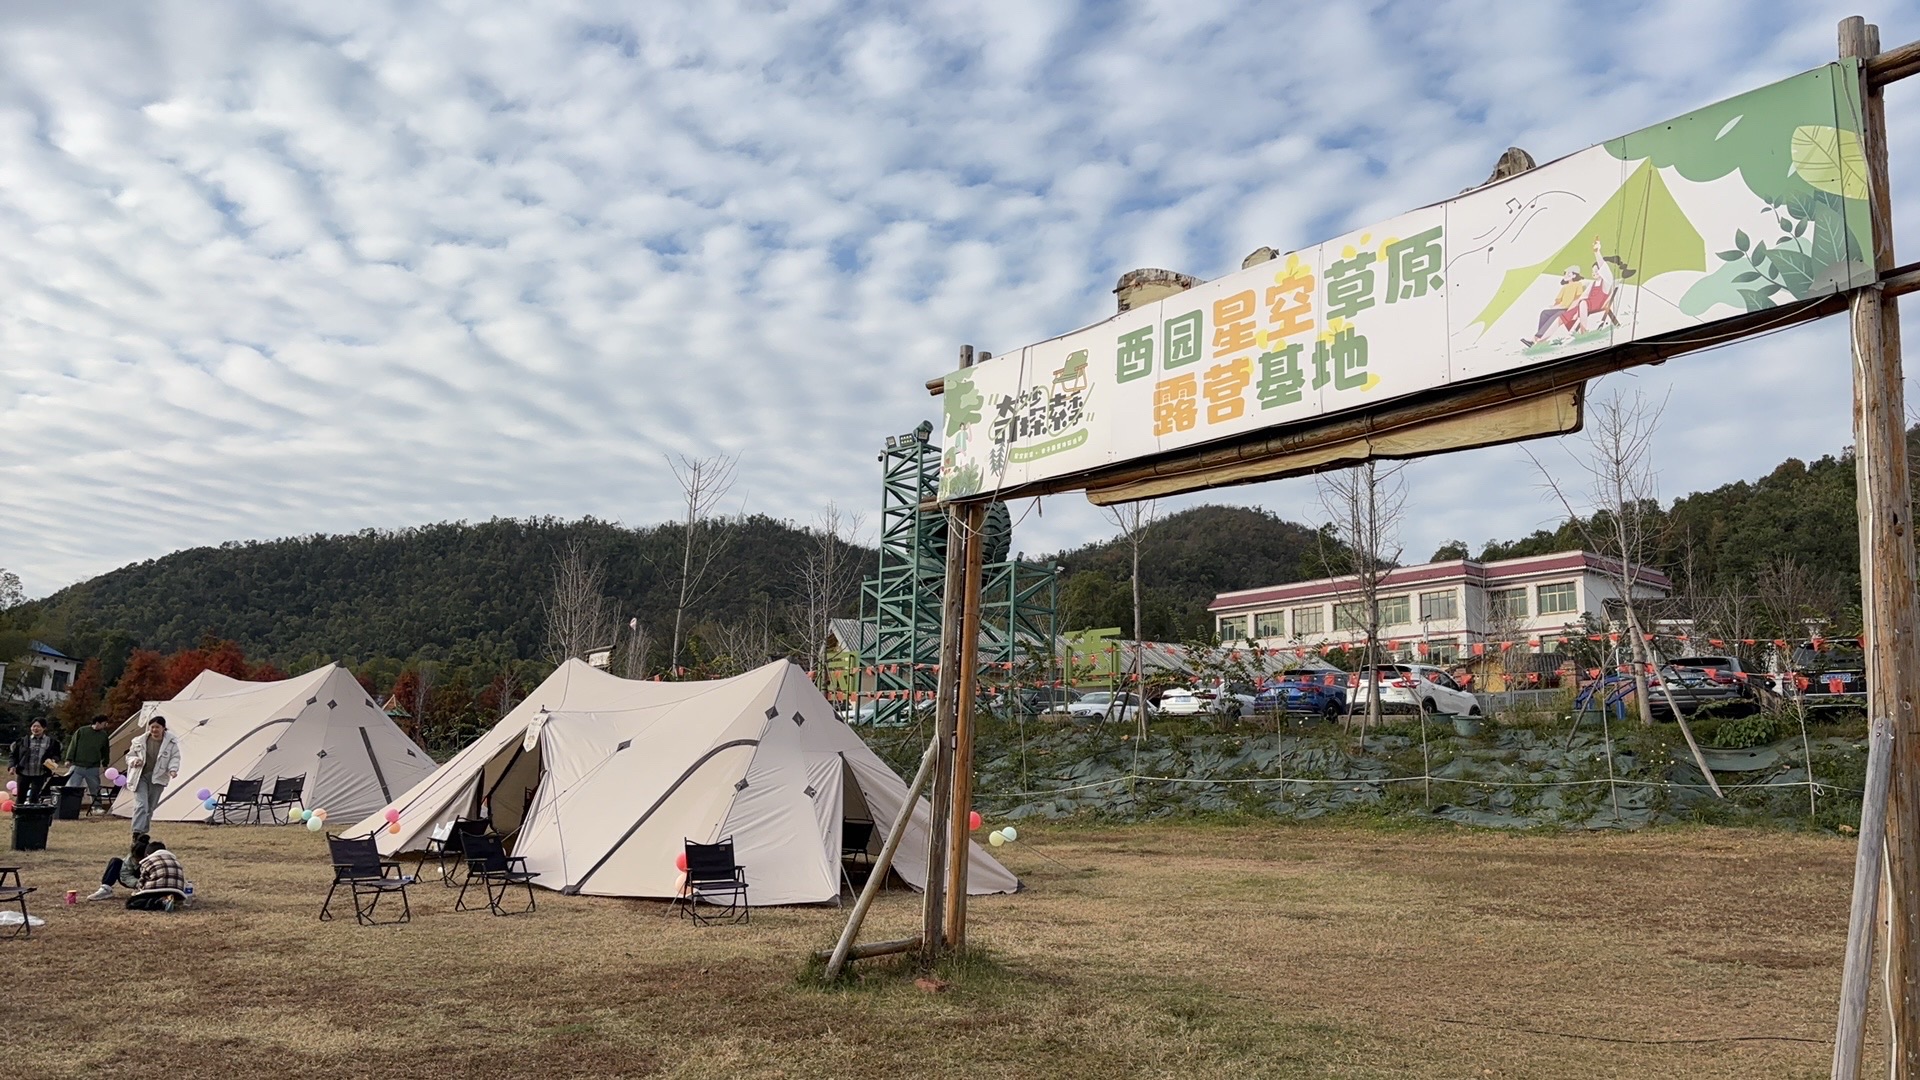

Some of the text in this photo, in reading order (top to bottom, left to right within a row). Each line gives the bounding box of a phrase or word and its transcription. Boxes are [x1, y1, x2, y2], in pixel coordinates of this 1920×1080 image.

[1116, 225, 1445, 384] 西园星空草原
[1152, 326, 1368, 437] 露营基地
